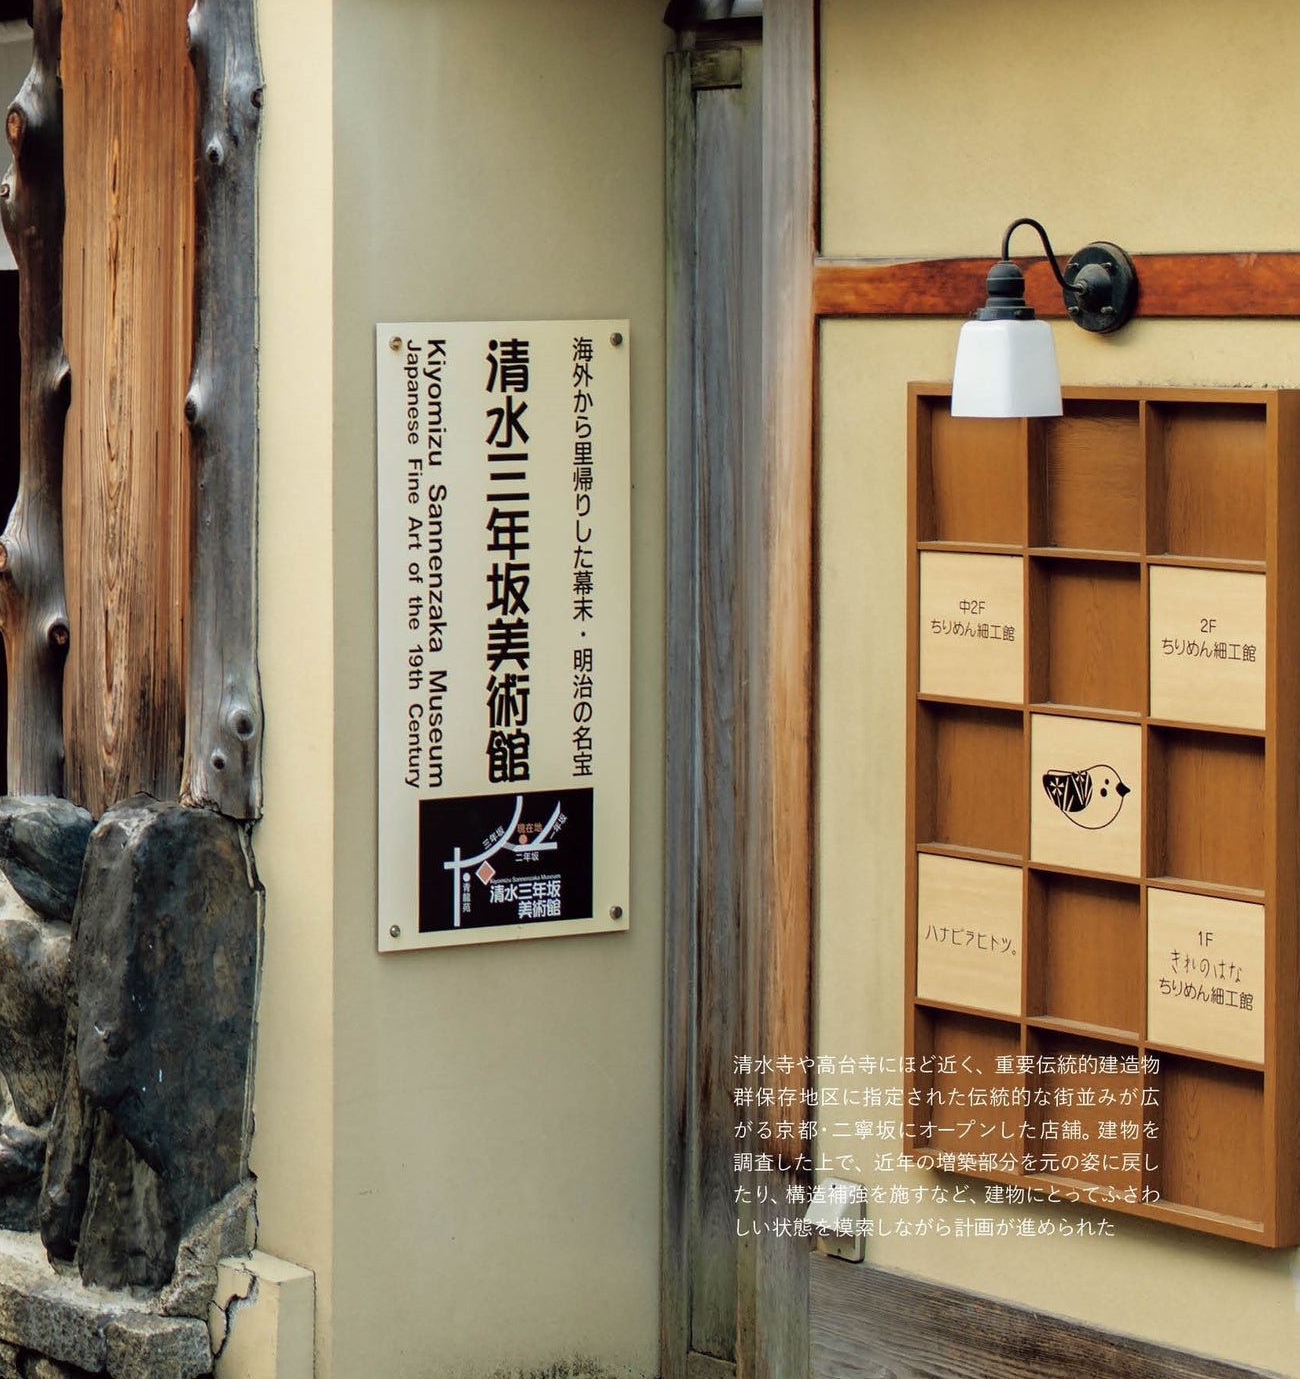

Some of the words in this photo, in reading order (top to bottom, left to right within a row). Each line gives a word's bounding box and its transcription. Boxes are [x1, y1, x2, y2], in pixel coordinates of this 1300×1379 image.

[404, 339, 422, 445] Japanese
[423, 339, 447, 466] Kiyomizu
[408, 458, 423, 504] Fine
[408, 516, 423, 550] Art
[408, 562, 423, 583] of
[428, 484, 447, 653] Sannenzaka
[485, 337, 531, 784] 清水三年坂美術館
[571, 336, 594, 778] 海外から里帰りした幕末・明治の名宝
[408, 595, 423, 630] the
[959, 599, 986, 615] 中2F
[931, 618, 1015, 641] ちりめん細工館
[1200, 618, 1217, 633] 2F
[408, 644, 423, 690] 19th
[1162, 638, 1256, 662] ちりめん細工館
[428, 669, 448, 788] Museum
[405, 703, 423, 789] Century
[490, 880, 561, 903] 清水三年坂
[518, 899, 561, 919] 美術館
[1198, 930, 1213, 947] 1F
[1171, 949, 1242, 983] きれのはな
[1159, 977, 1253, 1011] ちりめん細工館
